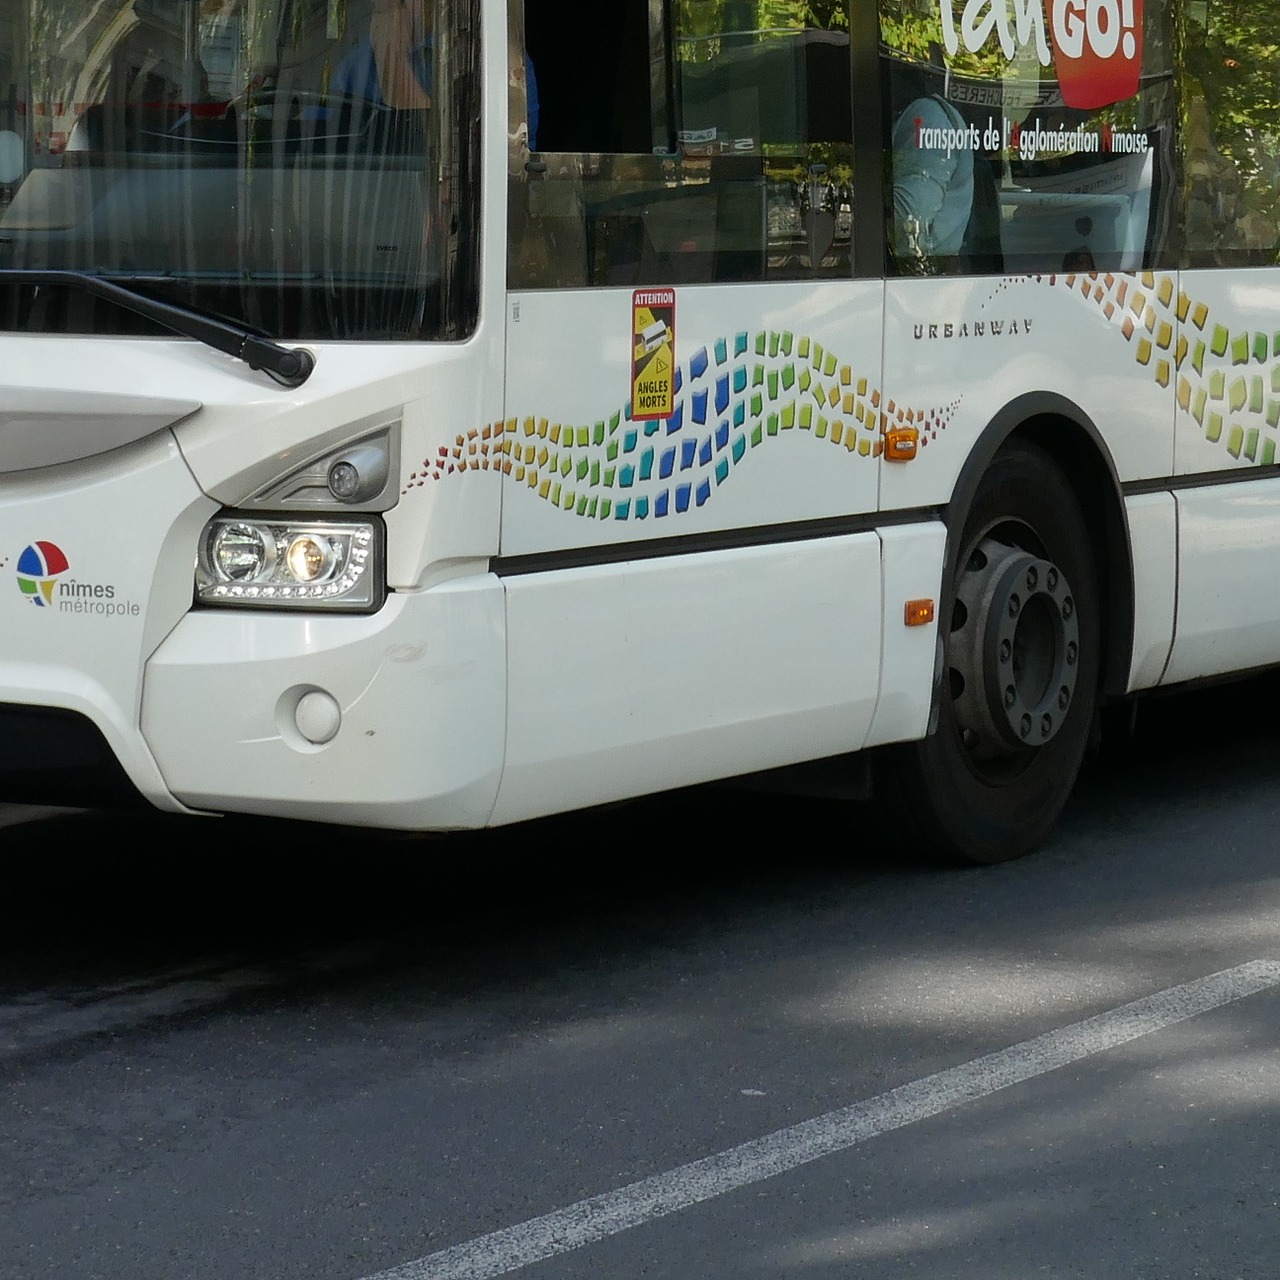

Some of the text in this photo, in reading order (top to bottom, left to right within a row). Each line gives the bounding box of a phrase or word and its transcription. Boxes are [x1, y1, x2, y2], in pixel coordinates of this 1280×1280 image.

[913, 116, 980, 160] Transports
[983, 116, 1000, 151] de
[1102, 122, 1149, 154] Nîmoise
[635, 292, 674, 305] ATTENTION
[914, 319, 1032, 340] URBANWAY
[638, 380, 668, 395] ANGLES
[639, 394, 667, 409] MORTS
[59, 578, 115, 599] nîmes
[60, 598, 140, 618] métropole
